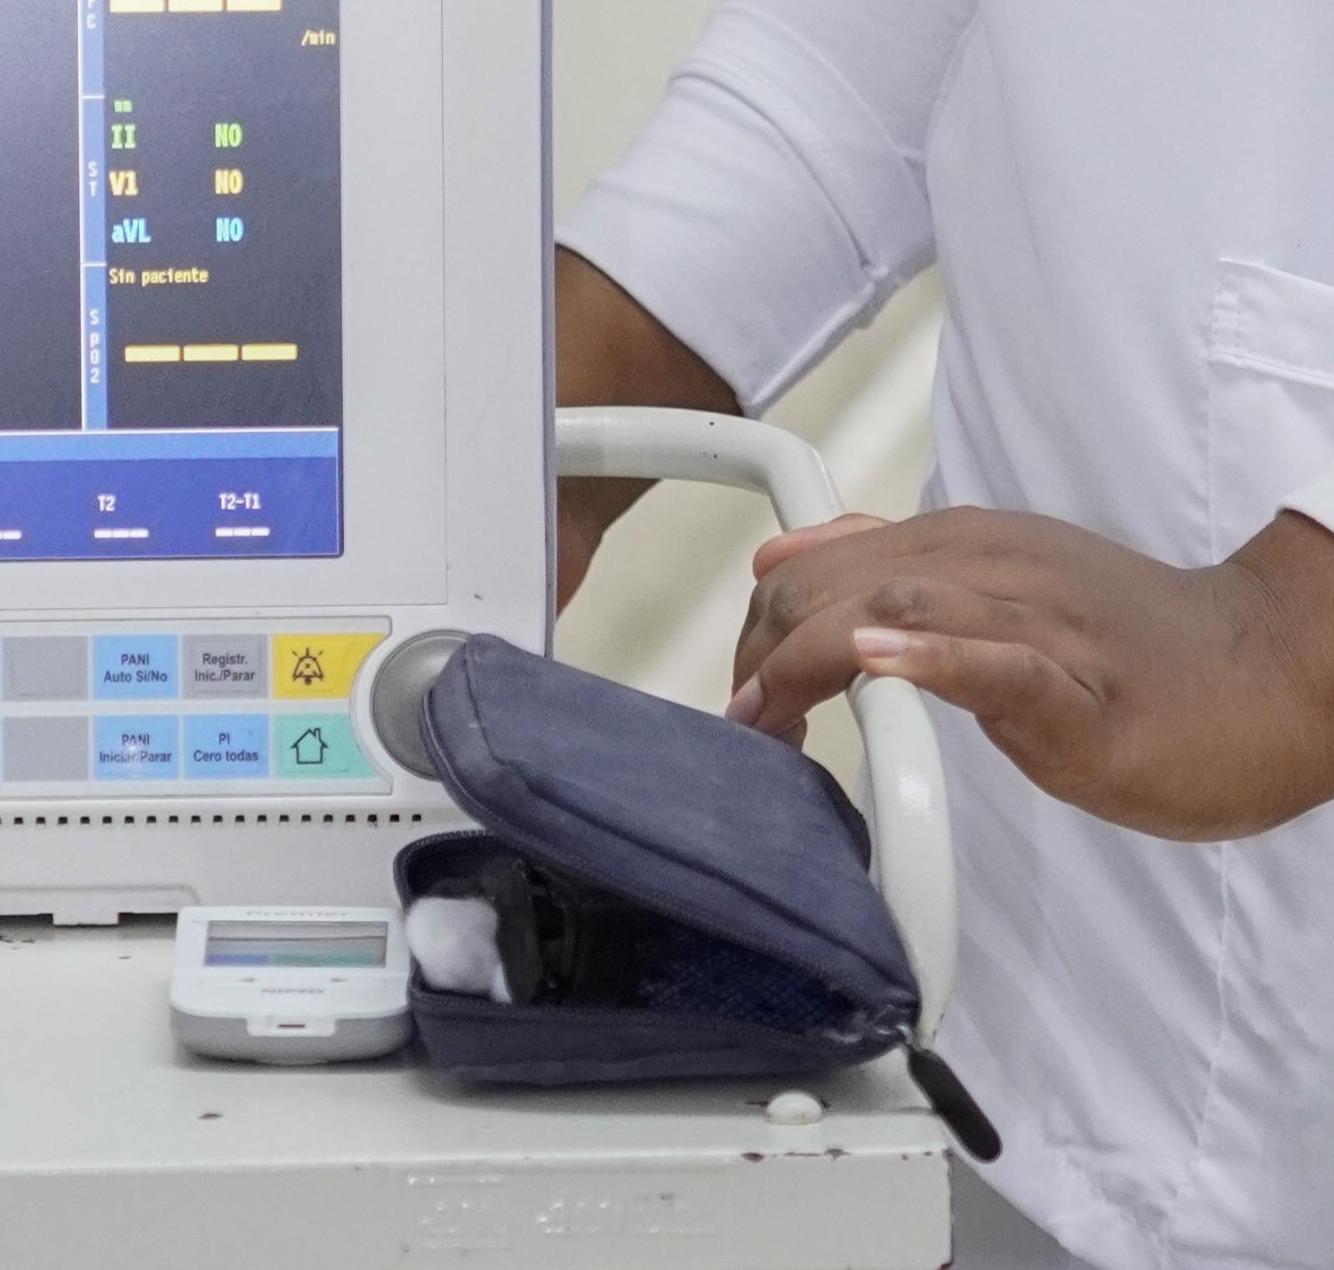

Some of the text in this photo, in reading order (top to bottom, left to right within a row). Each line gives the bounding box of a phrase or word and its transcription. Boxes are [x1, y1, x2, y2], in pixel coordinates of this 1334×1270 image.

[301, 30, 336, 46] /min
[111, 124, 243, 149] II NO
[109, 169, 244, 196] V1 NO
[111, 218, 244, 243] aVL NO
[109, 267, 209, 287] Sin paciente
[97, 495, 116, 512] T2
[219, 493, 261, 510] T2-T1
[120, 654, 151, 666] PANI
[202, 653, 248, 667] Registr.
[103, 669, 168, 683] Auto Sí/No
[194, 668, 256, 682] Inic./Parar
[121, 734, 151, 746] PANI
[218, 733, 231, 745] PI
[99, 751, 172, 764] Iniciar/Parar
[193, 749, 259, 763] Cero todas
